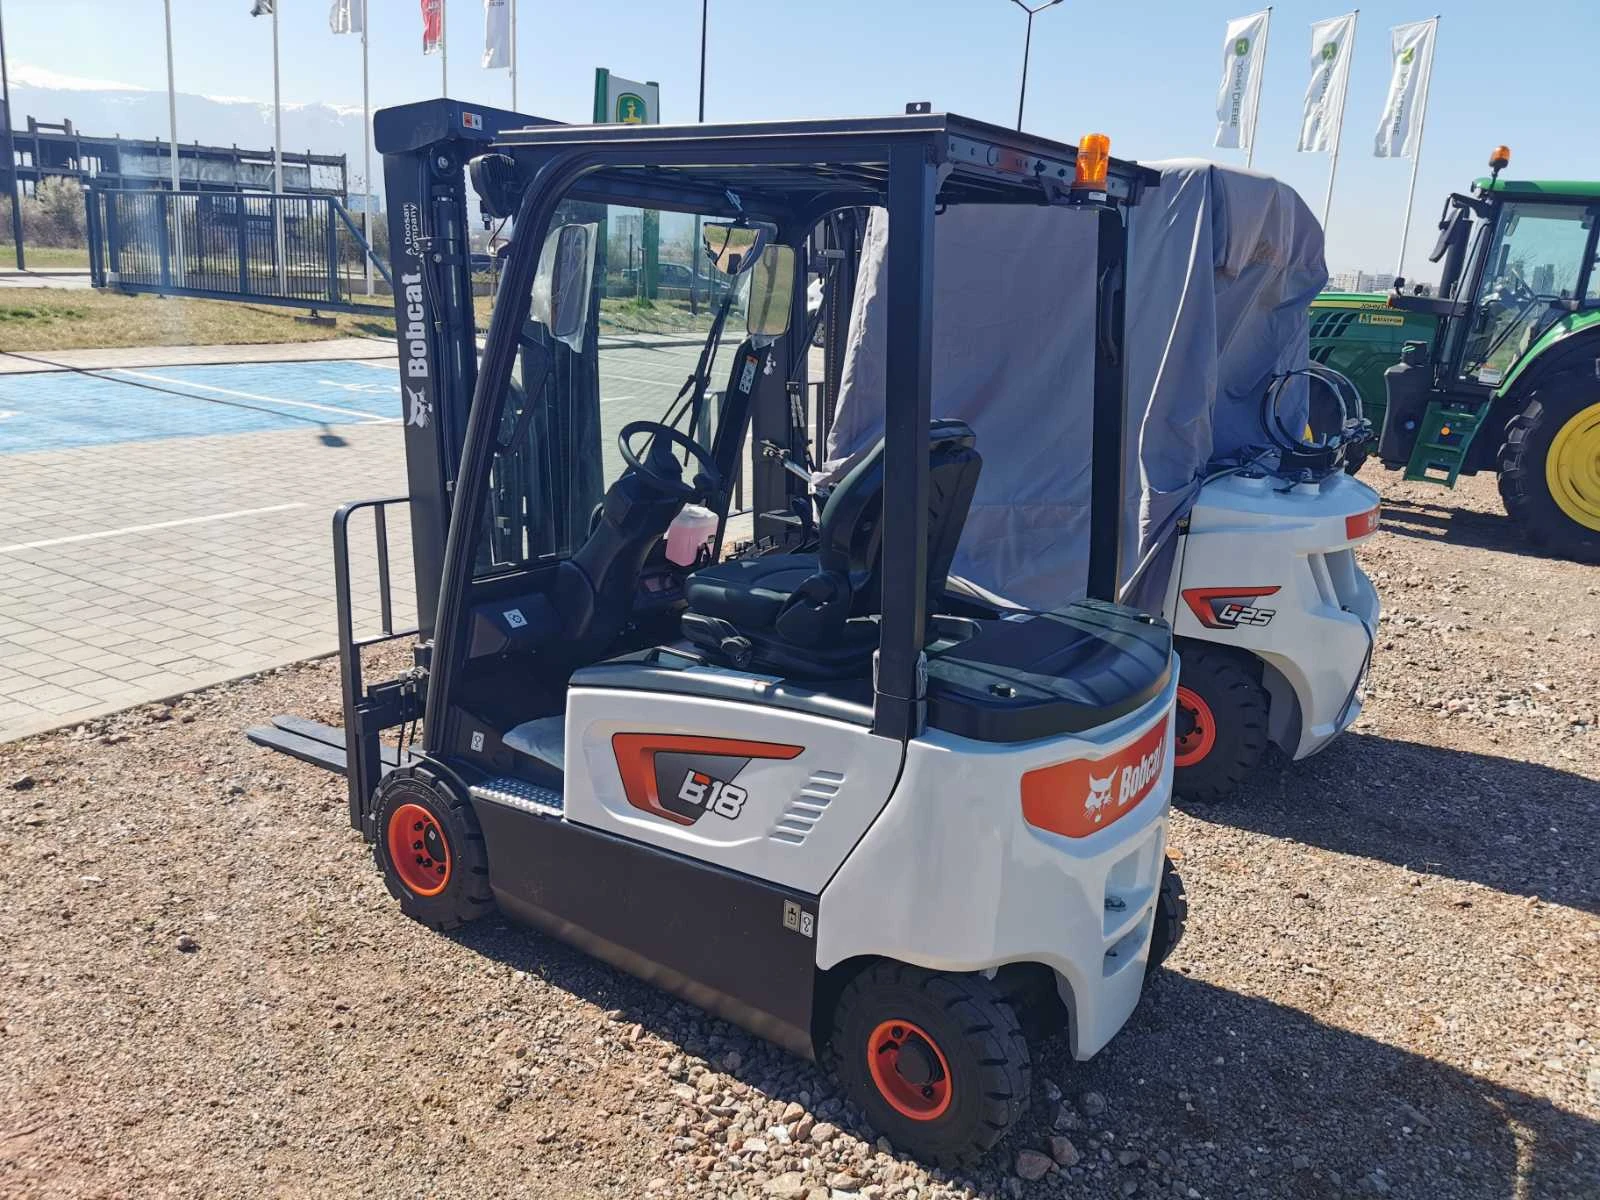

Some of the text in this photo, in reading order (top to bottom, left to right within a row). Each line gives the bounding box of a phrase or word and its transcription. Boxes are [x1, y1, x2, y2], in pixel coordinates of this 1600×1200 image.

[403, 204, 412, 245] Doosan
[409, 204, 420, 256] Company
[401, 272, 429, 378] Bobcat
[678, 769, 748, 820] B18
